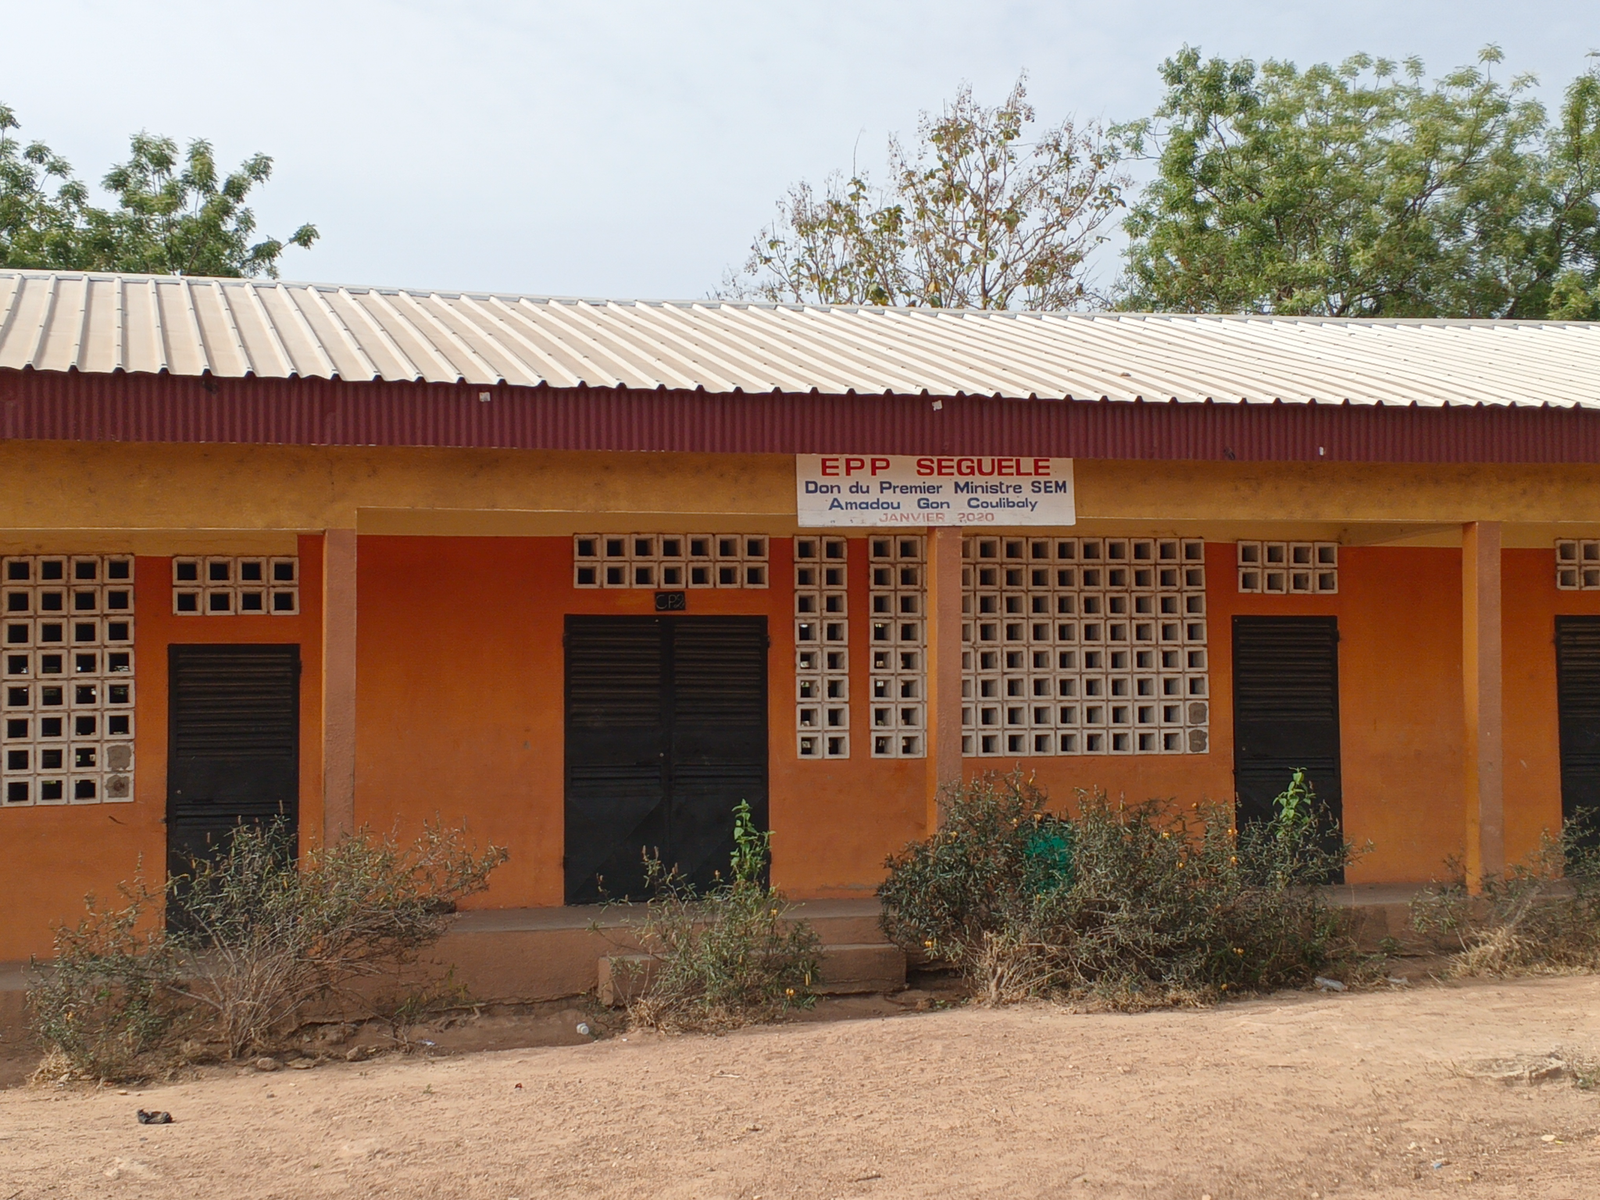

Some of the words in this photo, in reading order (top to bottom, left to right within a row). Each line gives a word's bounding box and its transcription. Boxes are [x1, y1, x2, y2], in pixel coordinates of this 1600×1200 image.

[821, 458, 891, 477] EPP
[916, 458, 1051, 477] SEGUELE
[805, 481, 841, 494] Don
[849, 481, 870, 494] du
[880, 481, 943, 494] Premier
[954, 480, 1022, 494] Ministre
[1031, 480, 1067, 494] SEM
[829, 498, 901, 511] Amadou
[917, 498, 950, 510] Gon
[967, 497, 1038, 511] Coulibaly
[879, 512, 945, 523] JANVIER
[957, 512, 995, 522] 2020
